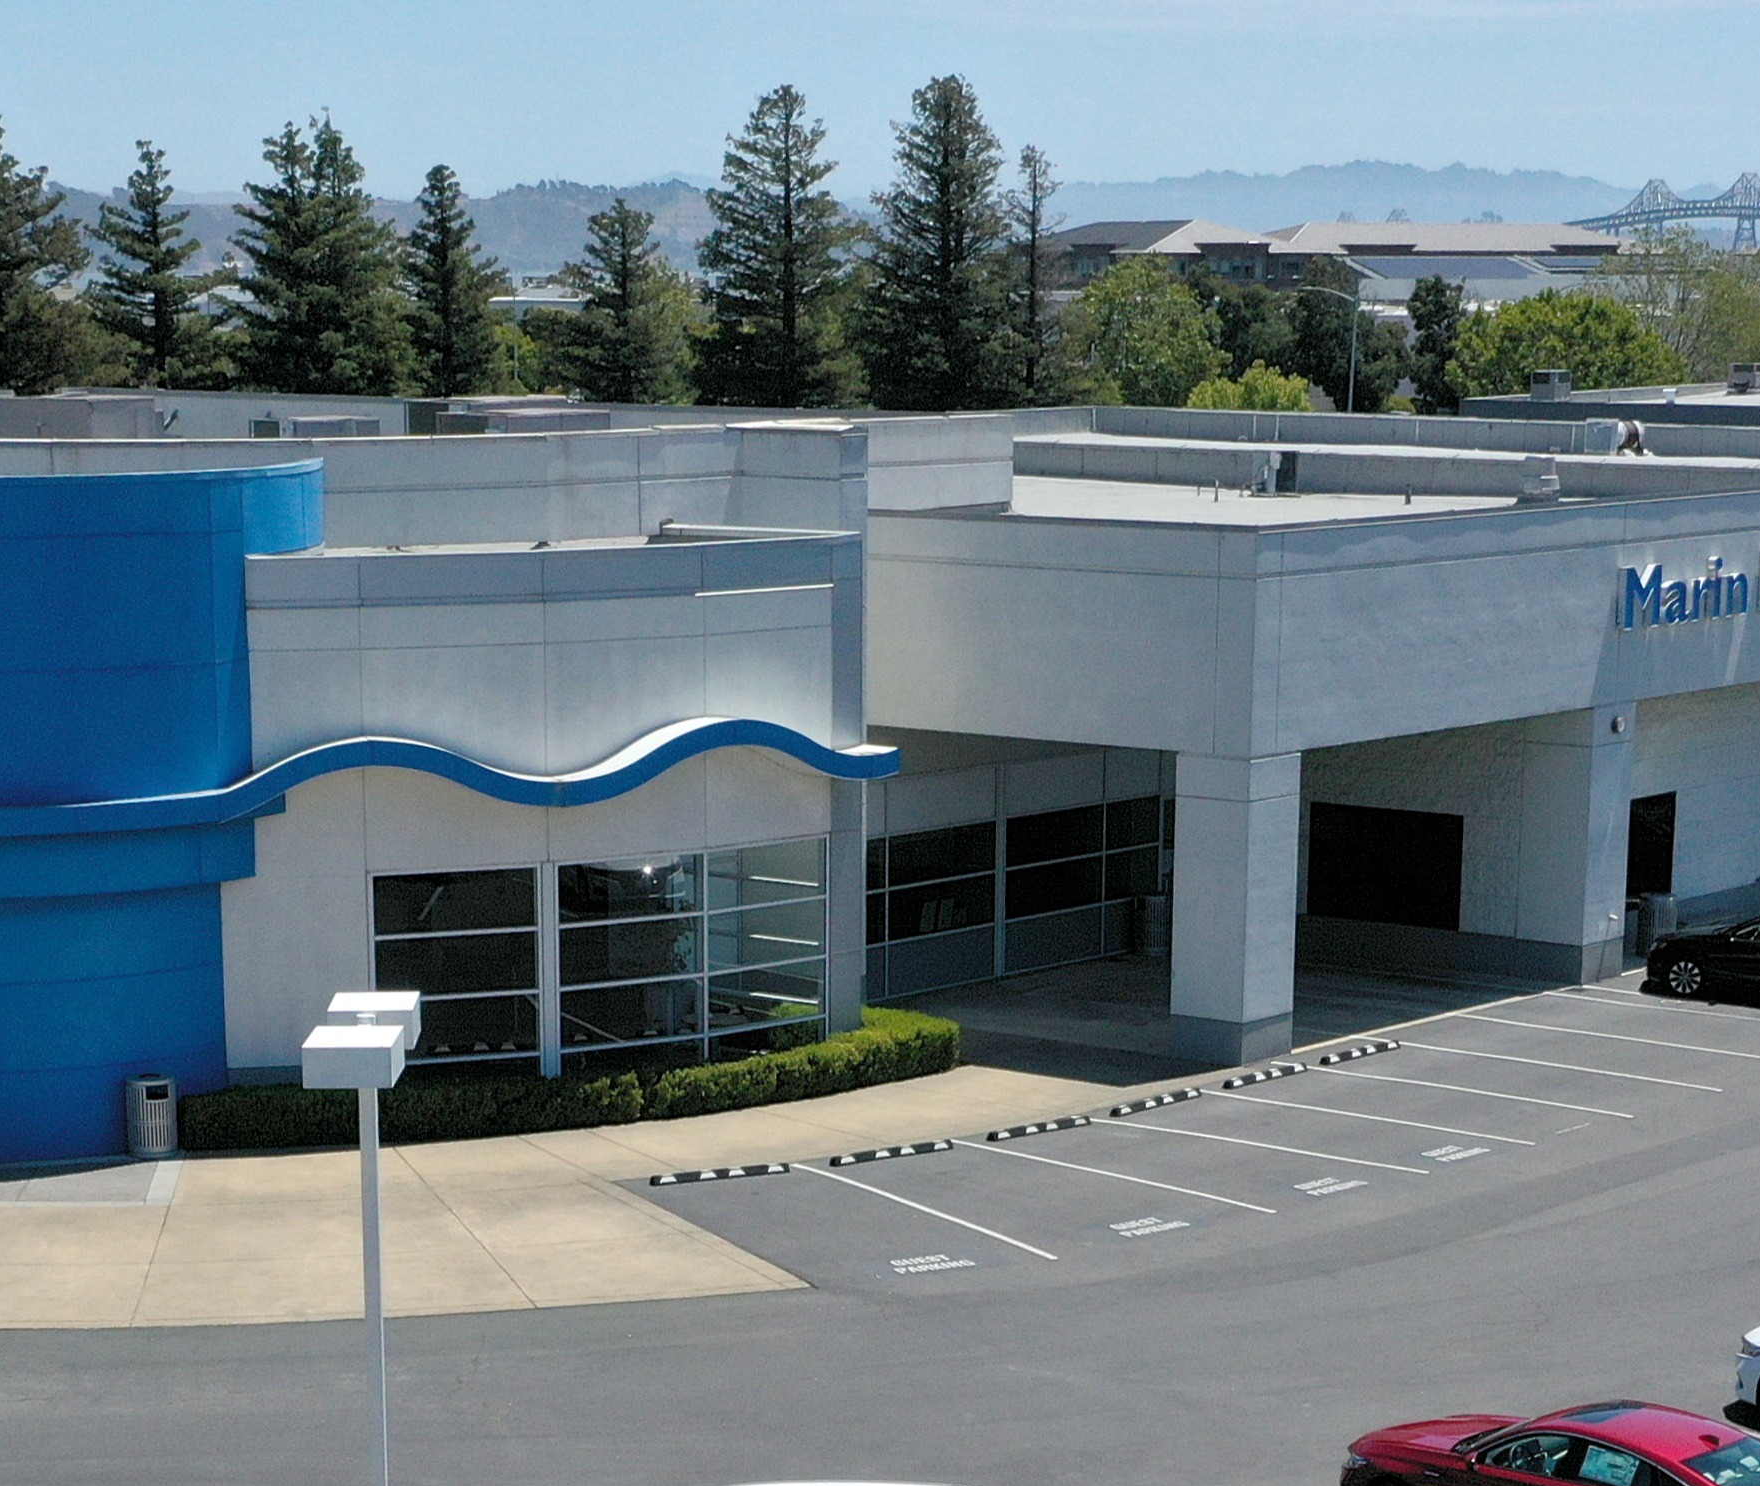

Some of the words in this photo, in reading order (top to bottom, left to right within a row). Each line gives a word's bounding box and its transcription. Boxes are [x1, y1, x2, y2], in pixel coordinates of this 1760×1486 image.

[1617, 555, 1749, 631] Marin
[890, 1254, 950, 1267] GUEST
[893, 1259, 977, 1275] PARKING
